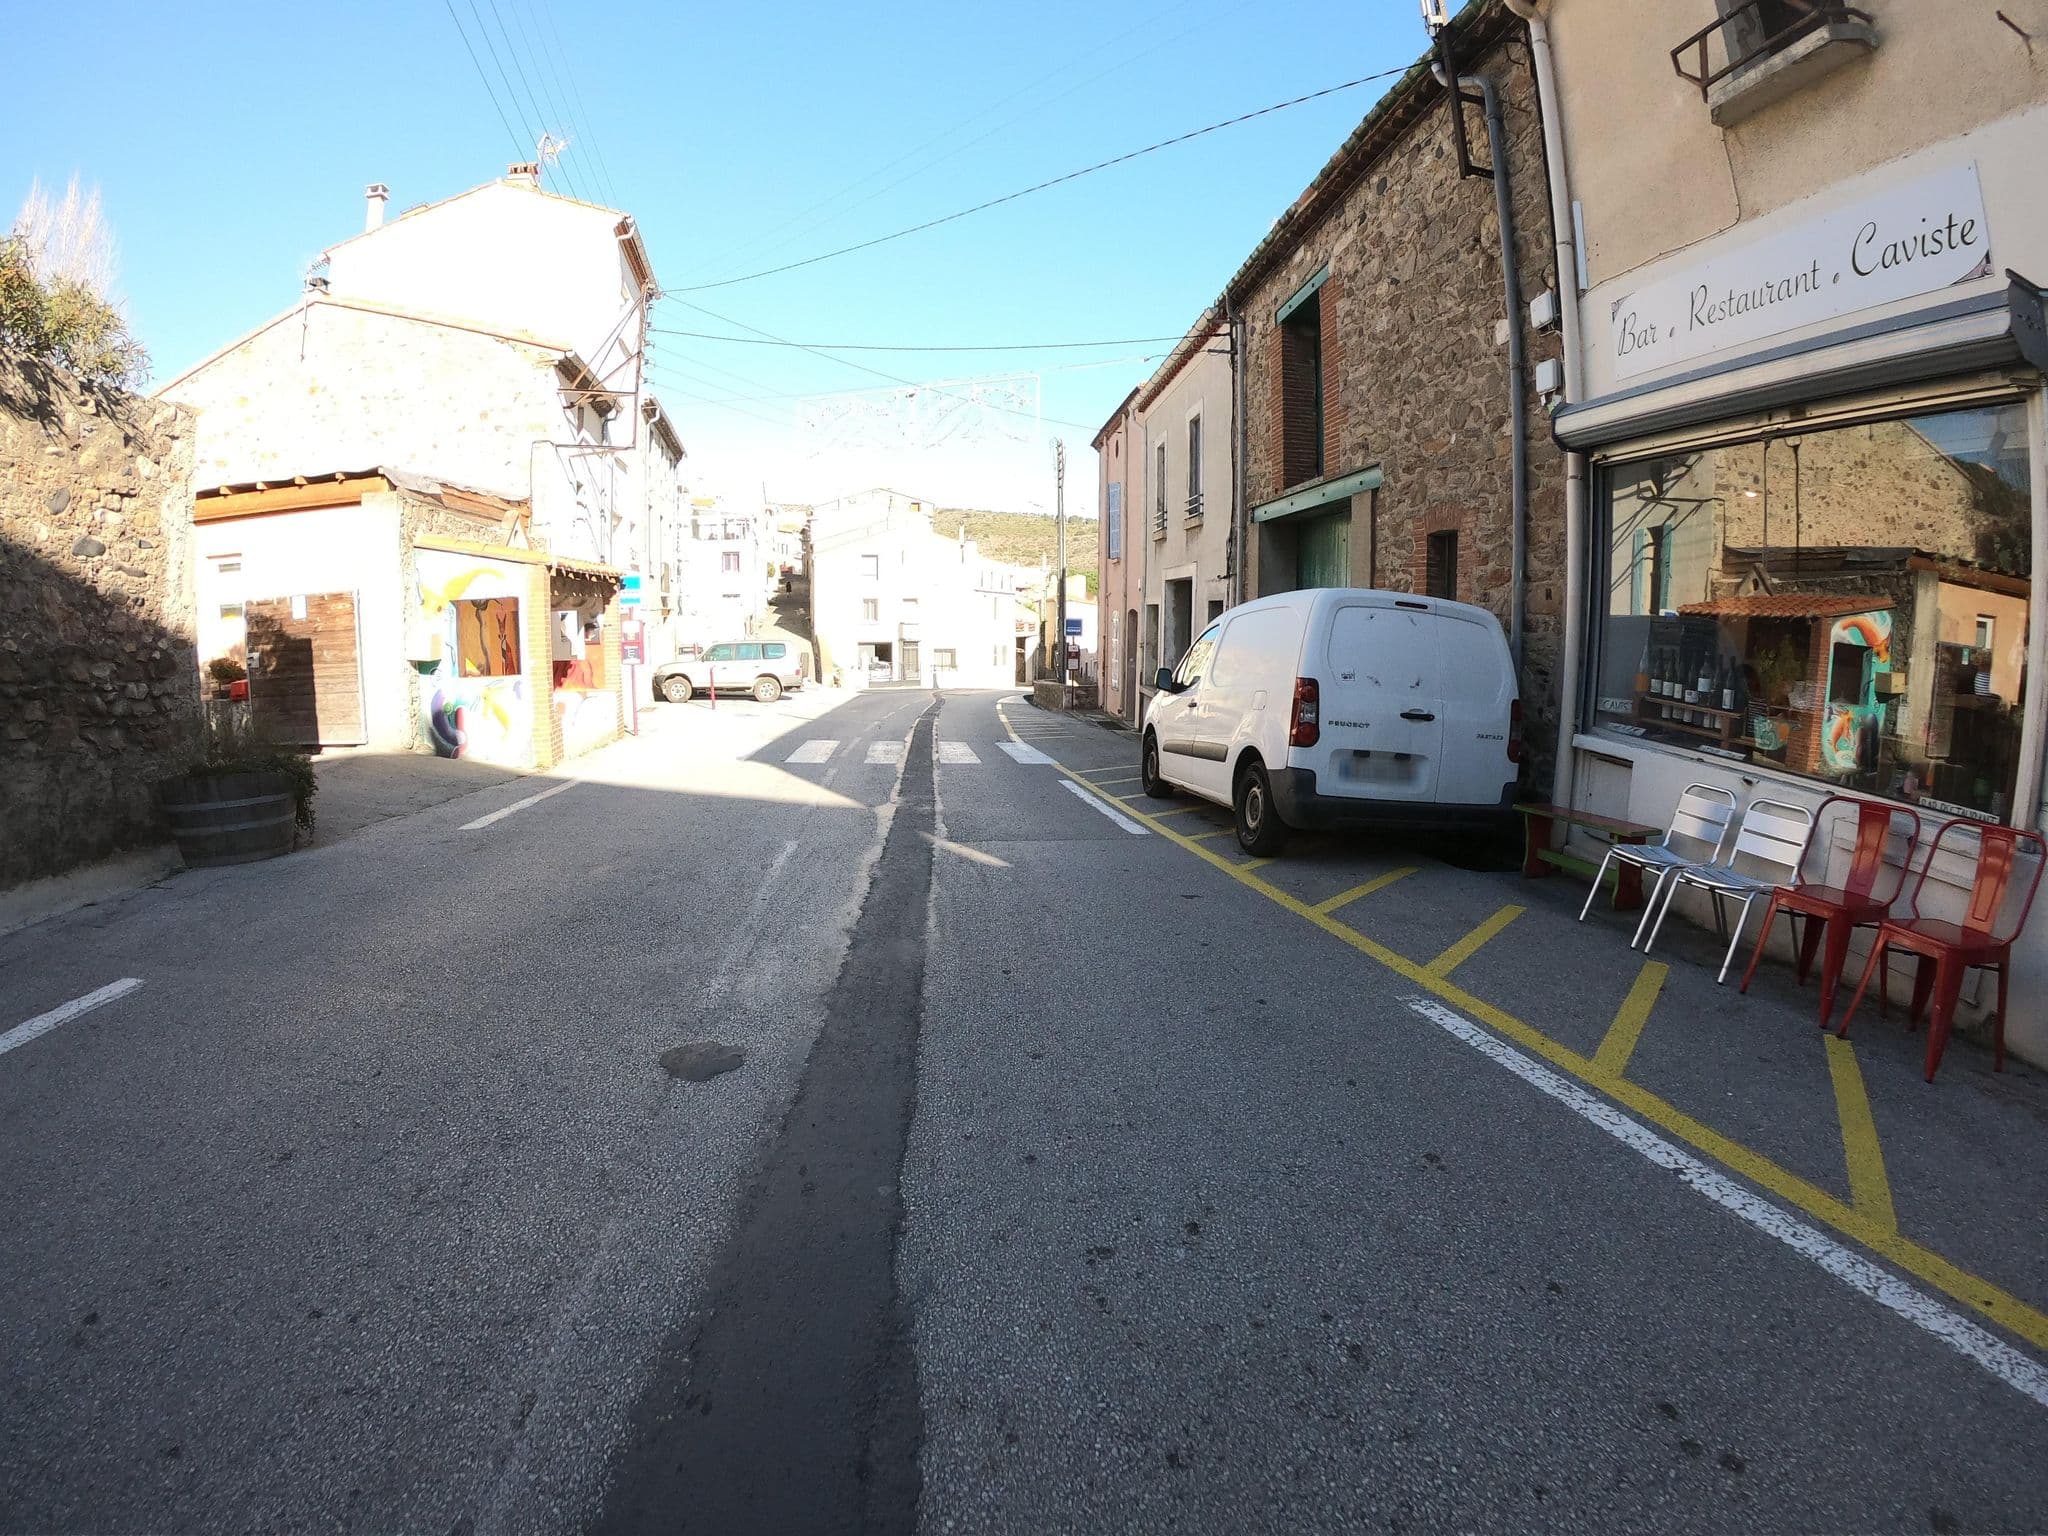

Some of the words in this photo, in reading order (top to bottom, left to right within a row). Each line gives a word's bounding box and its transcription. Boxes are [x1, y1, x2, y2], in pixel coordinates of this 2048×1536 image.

[1617, 311, 1658, 357] Bar
[1688, 258, 1821, 332] Restaurant
[1850, 212, 1979, 278] Caviste
